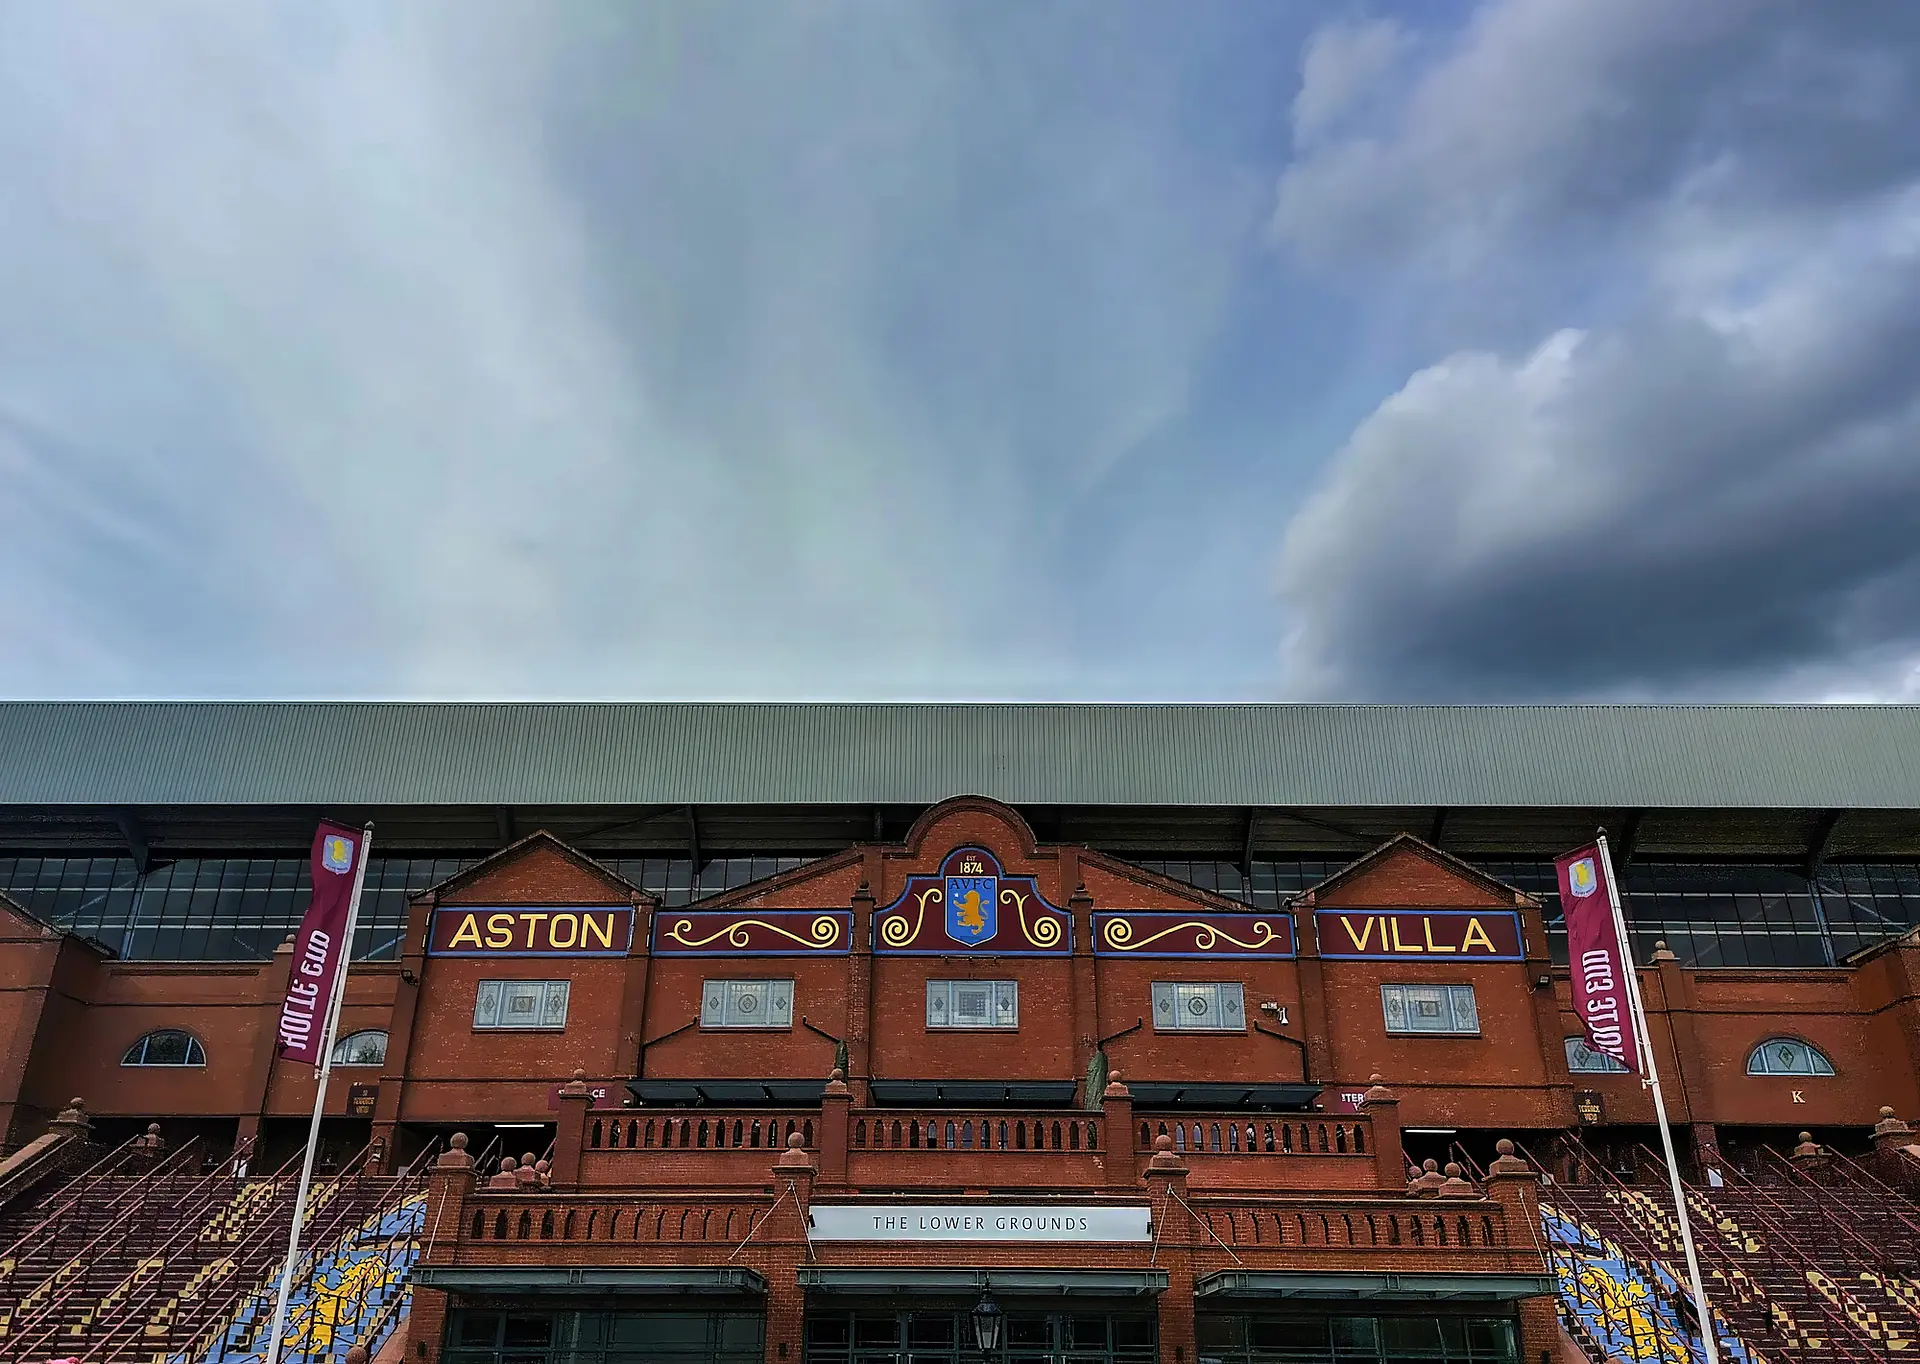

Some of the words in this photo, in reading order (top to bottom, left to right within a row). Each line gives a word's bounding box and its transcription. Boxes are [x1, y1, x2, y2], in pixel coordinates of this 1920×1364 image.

[960, 862, 983, 874] 1874
[949, 878, 993, 890] AVFC
[448, 913, 615, 948] ASTON
[1340, 916, 1497, 953] VILLA
[1791, 1090, 1806, 1104] K
[873, 1216, 908, 1230] THE
[919, 1216, 985, 1231] LOWER
[995, 1216, 1088, 1231] GROUNDS
